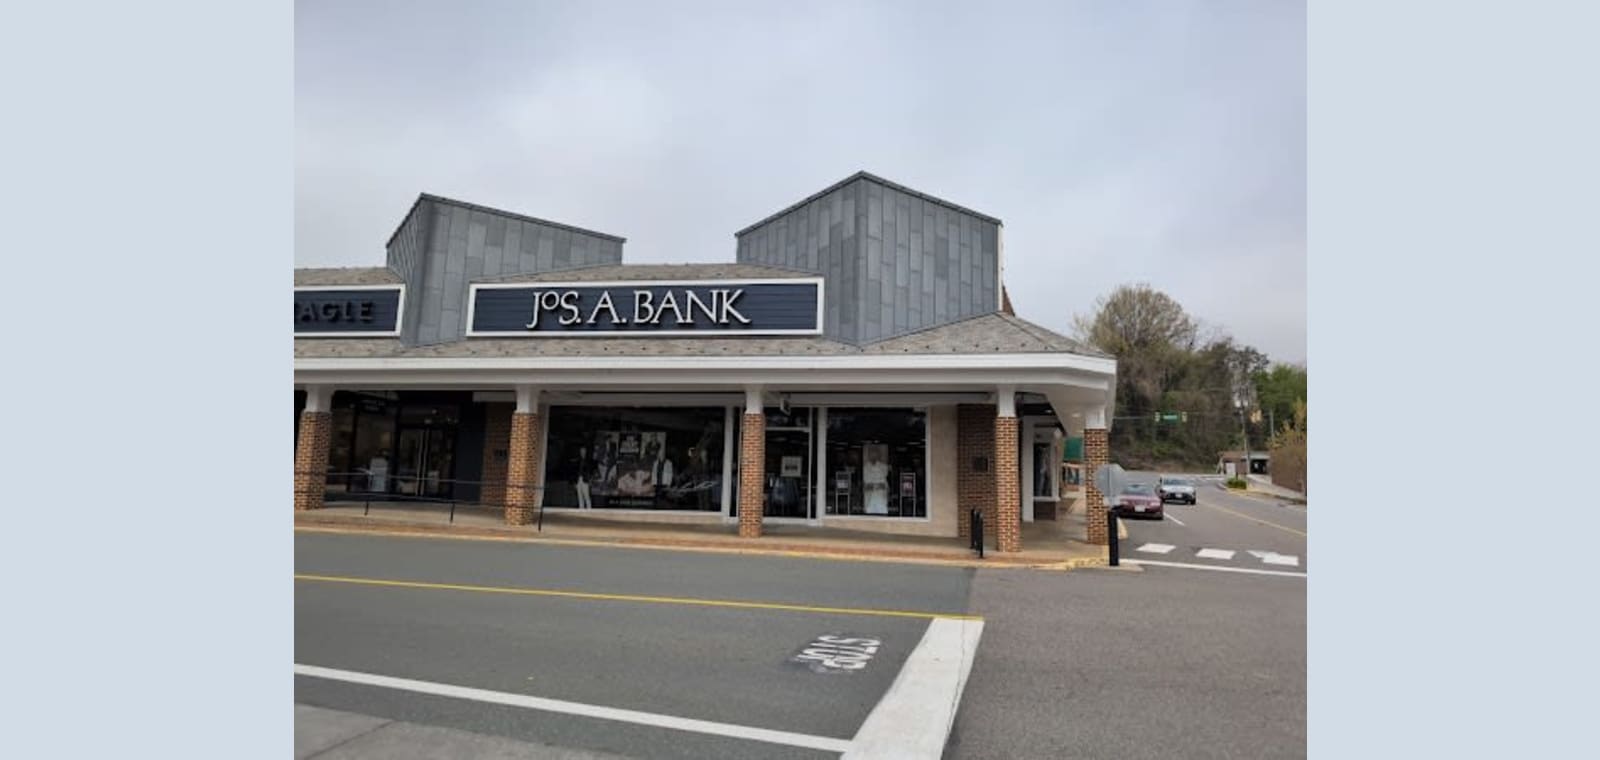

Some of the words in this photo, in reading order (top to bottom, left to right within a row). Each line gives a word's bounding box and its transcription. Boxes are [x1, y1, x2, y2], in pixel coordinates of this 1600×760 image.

[294, 300, 375, 323] AGLE
[587, 290, 628, 325] A.
[633, 289, 752, 325] BANK
[795, 634, 882, 671] STOP
